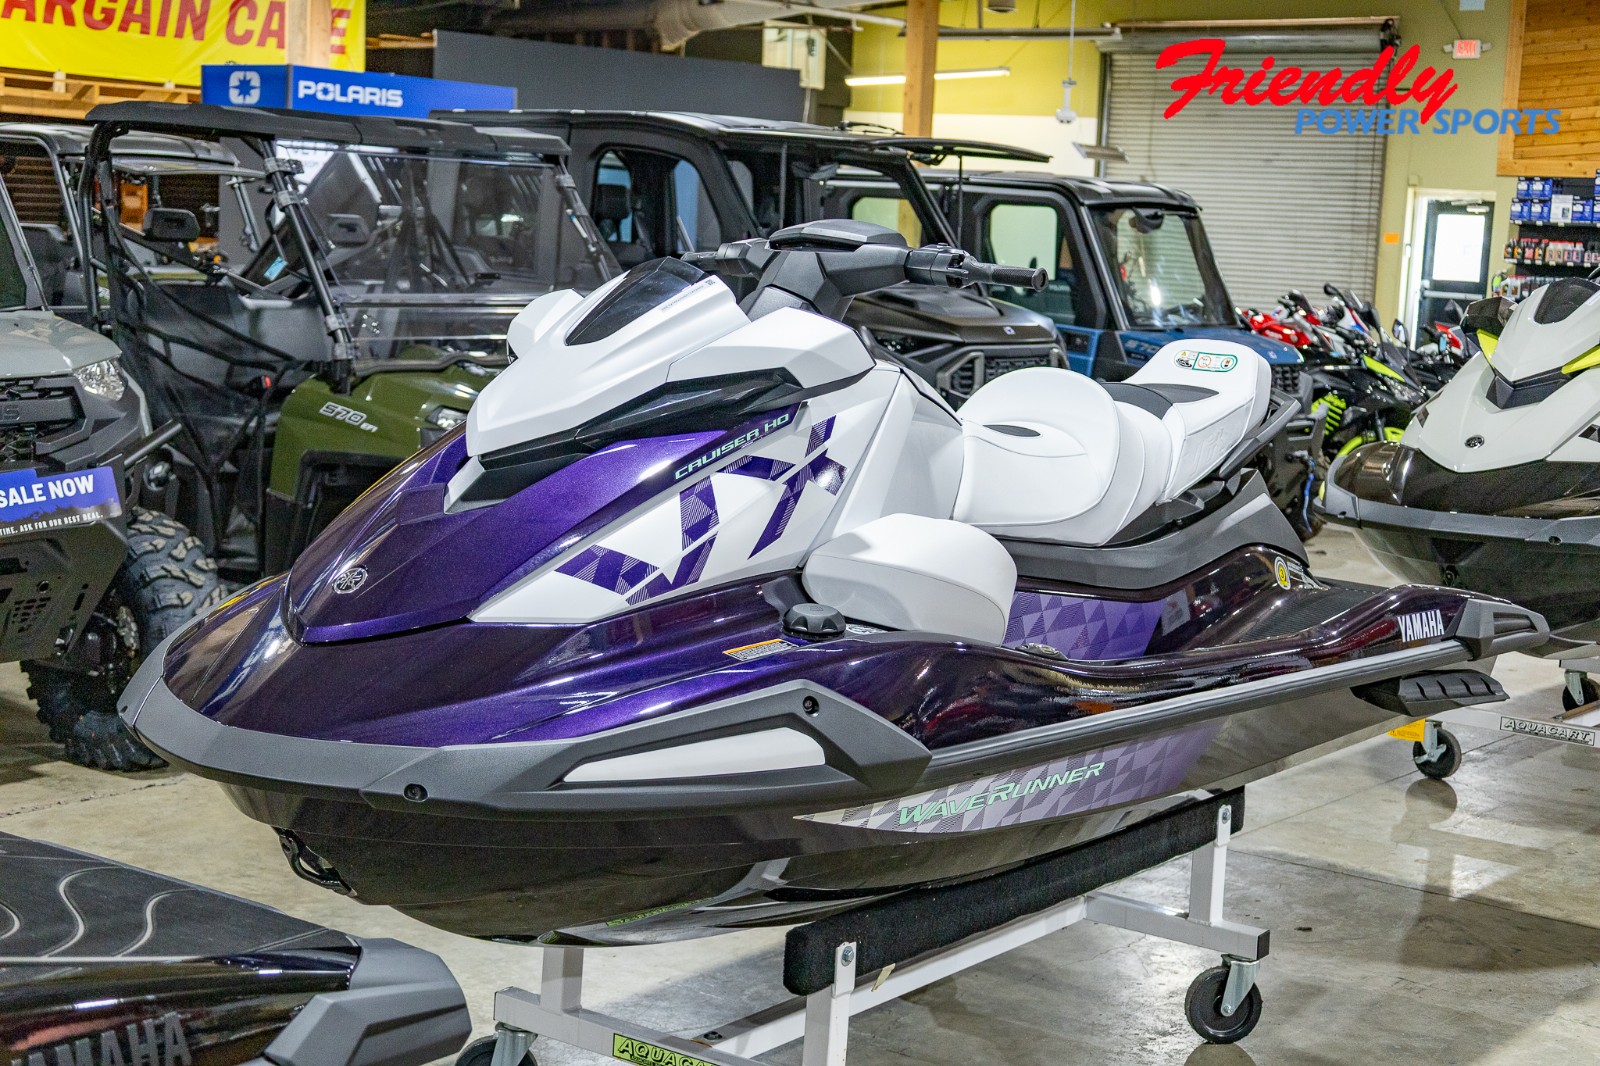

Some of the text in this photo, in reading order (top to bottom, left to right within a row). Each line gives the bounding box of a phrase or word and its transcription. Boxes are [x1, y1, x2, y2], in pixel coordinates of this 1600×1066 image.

[225, 0, 350, 54] CAE
[298, 80, 404, 108] POLARIS
[675, 413, 789, 480] CRUISER HO
[0, 474, 94, 508] SALE NOW
[20, 523, 34, 533] ASK
[34, 521, 48, 530] FOR
[63, 514, 81, 525] BEST
[1397, 609, 1445, 643] YAMAHA
[1504, 719, 1590, 741] AQUACART
[11, 1011, 193, 1066] MAHA
[618, 1038, 706, 1066] AQUAC
